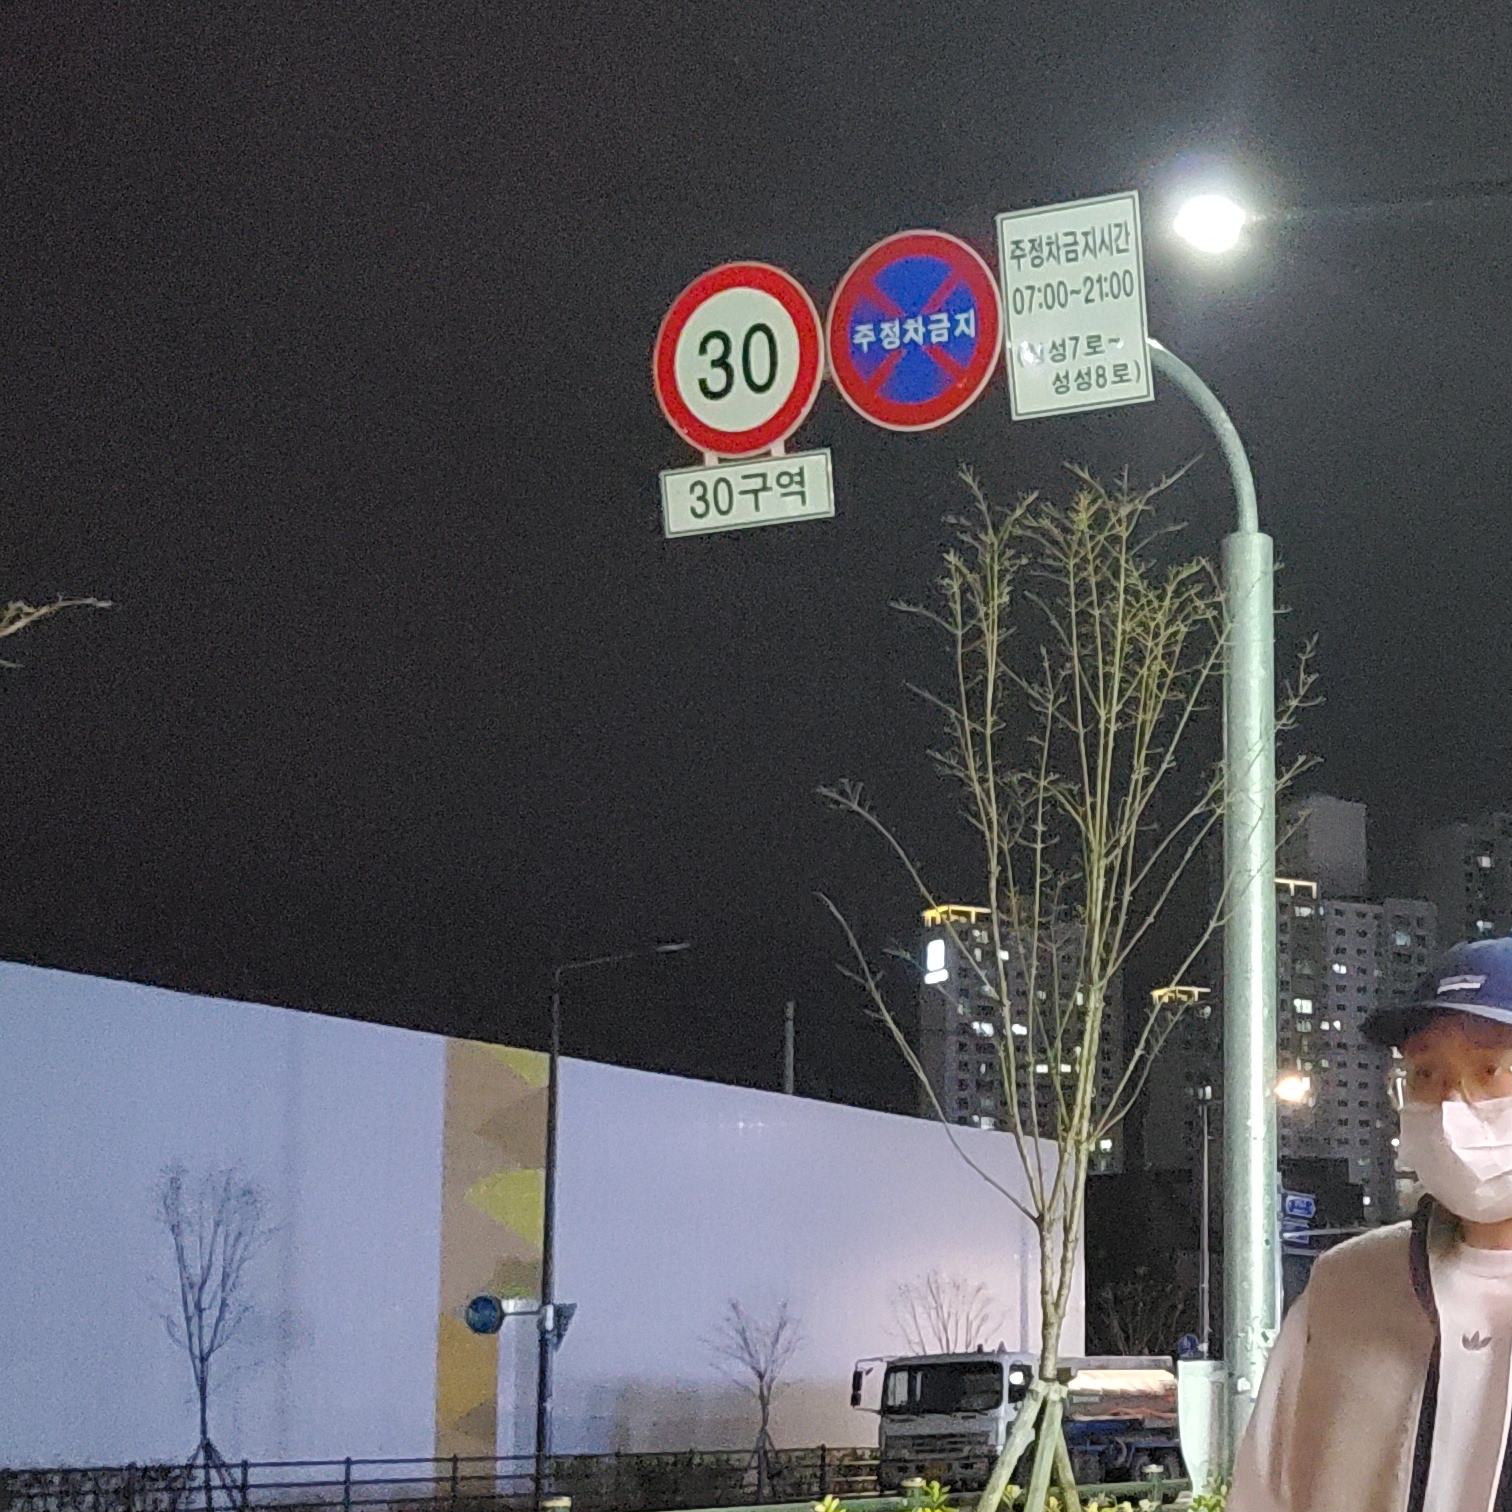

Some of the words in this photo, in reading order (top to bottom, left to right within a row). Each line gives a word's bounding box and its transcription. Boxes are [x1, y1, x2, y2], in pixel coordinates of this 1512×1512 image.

[1010, 220, 1131, 272] 주정차금지시간
[852, 307, 976, 354] 주정차금지
[697, 322, 778, 401] 30
[1052, 359, 1141, 395] 성성8로)
[689, 465, 806, 519] 30구역
